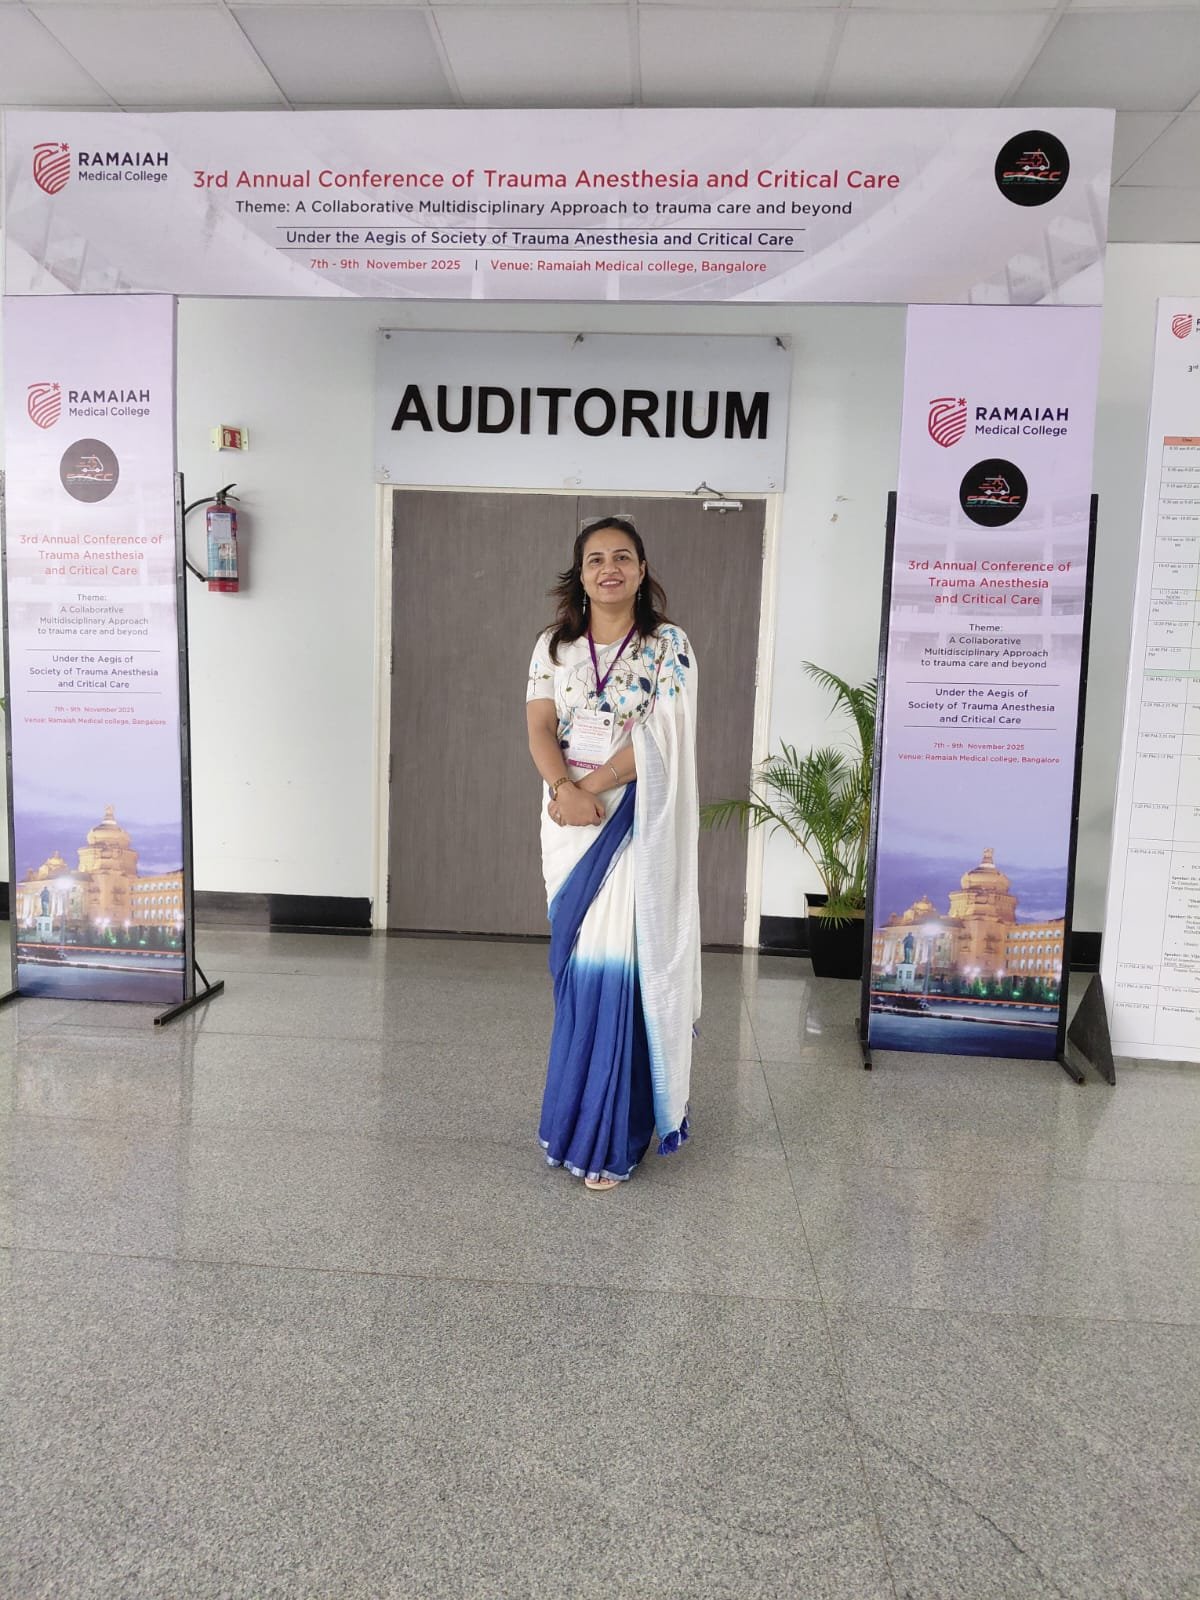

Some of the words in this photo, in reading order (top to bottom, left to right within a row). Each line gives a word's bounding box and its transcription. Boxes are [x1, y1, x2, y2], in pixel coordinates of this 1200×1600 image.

[79, 152, 168, 166] RAMAIAH
[79, 171, 121, 181] Medical
[125, 171, 167, 183] College
[194, 170, 228, 188] 3rd
[236, 170, 310, 187] Annual
[319, 169, 444, 187] Conference
[452, 169, 474, 187] of
[484, 170, 566, 187] Trauma
[575, 170, 698, 187] Anesthesia
[707, 170, 748, 187] and
[758, 170, 838, 188] Critical
[847, 171, 899, 188] Care
[1002, 172, 1061, 182] STACC
[235, 200, 290, 213] Theme:
[296, 201, 306, 212] A
[312, 200, 413, 212] Collaborative
[419, 200, 544, 216] Multidisciplinary
[551, 201, 627, 216] Approach
[633, 202, 648, 213] to
[656, 202, 711, 213] trauma
[717, 204, 751, 214] care
[757, 201, 785, 214] and
[792, 201, 852, 216] beyond
[287, 231, 331, 243] Under
[336, 231, 359, 243] the
[365, 231, 406, 245] Aegis
[411, 231, 426, 243] of
[431, 232, 487, 247] Society
[492, 232, 507, 244] of
[512, 232, 568, 244] Trauma
[575, 232, 657, 245] Anesthesia
[664, 232, 692, 245] and
[698, 233, 752, 245] Critical
[758, 233, 794, 245] Care
[311, 259, 328, 268] 7th
[341, 259, 359, 269] 9th
[367, 259, 426, 269] November
[432, 260, 460, 270] 2025
[491, 260, 532, 270] Venue:
[538, 261, 591, 271] Ramaiah
[596, 260, 643, 271] Medical
[648, 260, 696, 273] college,
[702, 261, 766, 273] Bangalore
[69, 390, 149, 403] RAMAIAH
[69, 407, 108, 416] Medical
[111, 407, 150, 417] College
[391, 384, 769, 439] AUDITORIUM
[976, 407, 1068, 421] RAMAIAH
[975, 425, 1019, 434] Medical
[1023, 425, 1067, 437] College
[20, 534, 39, 544] 3rd
[41, 534, 80, 544] Annual
[83, 534, 147, 544] Conference
[151, 534, 163, 544] of
[39, 550, 79, 560] Trauma
[84, 551, 144, 560] Anesthesia
[45, 565, 65, 575] and
[69, 565, 108, 576] Critical
[112, 566, 138, 575] Care
[909, 560, 929, 569] 3rd
[933, 561, 976, 570] Annual
[982, 561, 1054, 571] Conference
[1057, 562, 1071, 571] of
[928, 577, 975, 587] Trauma
[980, 578, 1048, 588] Anesthesia
[77, 594, 107, 602] Theme:
[935, 593, 958, 603] and
[962, 594, 1006, 604] Critical
[1011, 595, 1041, 604] Care
[69, 605, 124, 613] Collaborative
[39, 617, 106, 626] Multidisciplinary
[108, 617, 148, 625] Approach
[99, 627, 115, 635] and
[117, 628, 148, 636] beyond
[969, 623, 1003, 632] Theme:
[949, 636, 956, 644] A
[959, 635, 1021, 645] Collaborative
[925, 648, 999, 657] Multidisciplinary
[1002, 649, 1049, 659] Approach
[52, 655, 78, 663] Under
[98, 656, 122, 664] Aegis
[1012, 660, 1046, 669] beyond
[30, 667, 60, 676] Society
[936, 688, 965, 696] Under
[987, 689, 1014, 698] Aegis
[908, 701, 944, 710] Society
[962, 702, 998, 710] Trauma
[1001, 703, 1054, 711] Anesthesia
[961, 715, 995, 723] Critical
[999, 716, 1021, 724] Care
